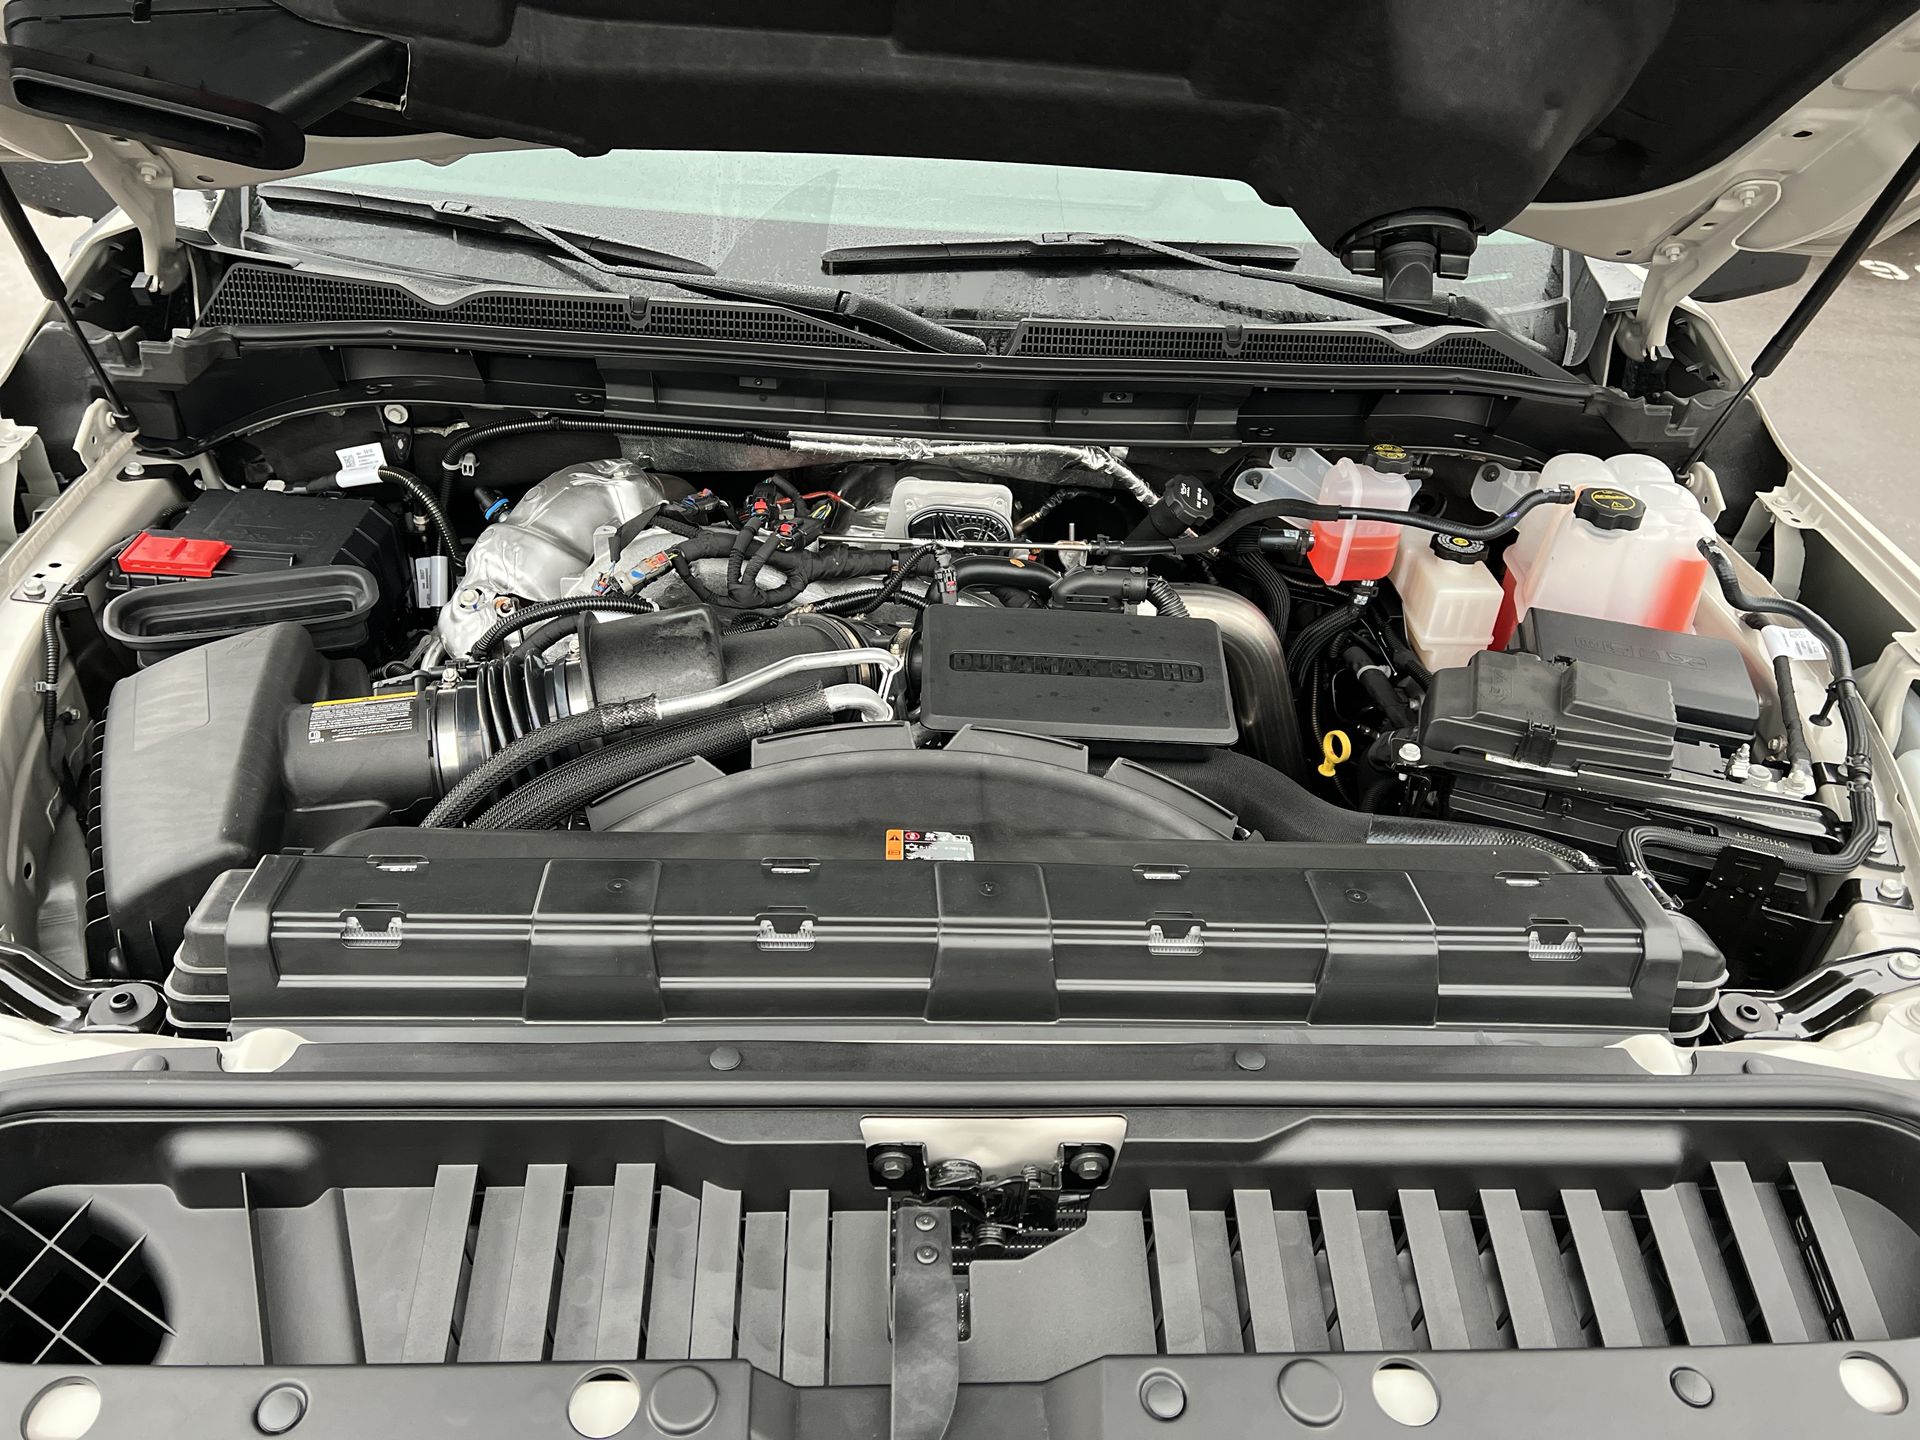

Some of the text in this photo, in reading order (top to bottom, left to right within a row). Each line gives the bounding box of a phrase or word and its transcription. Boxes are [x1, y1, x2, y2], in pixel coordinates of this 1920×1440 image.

[952, 652, 1203, 682] DURAMAX 6.6 HD
